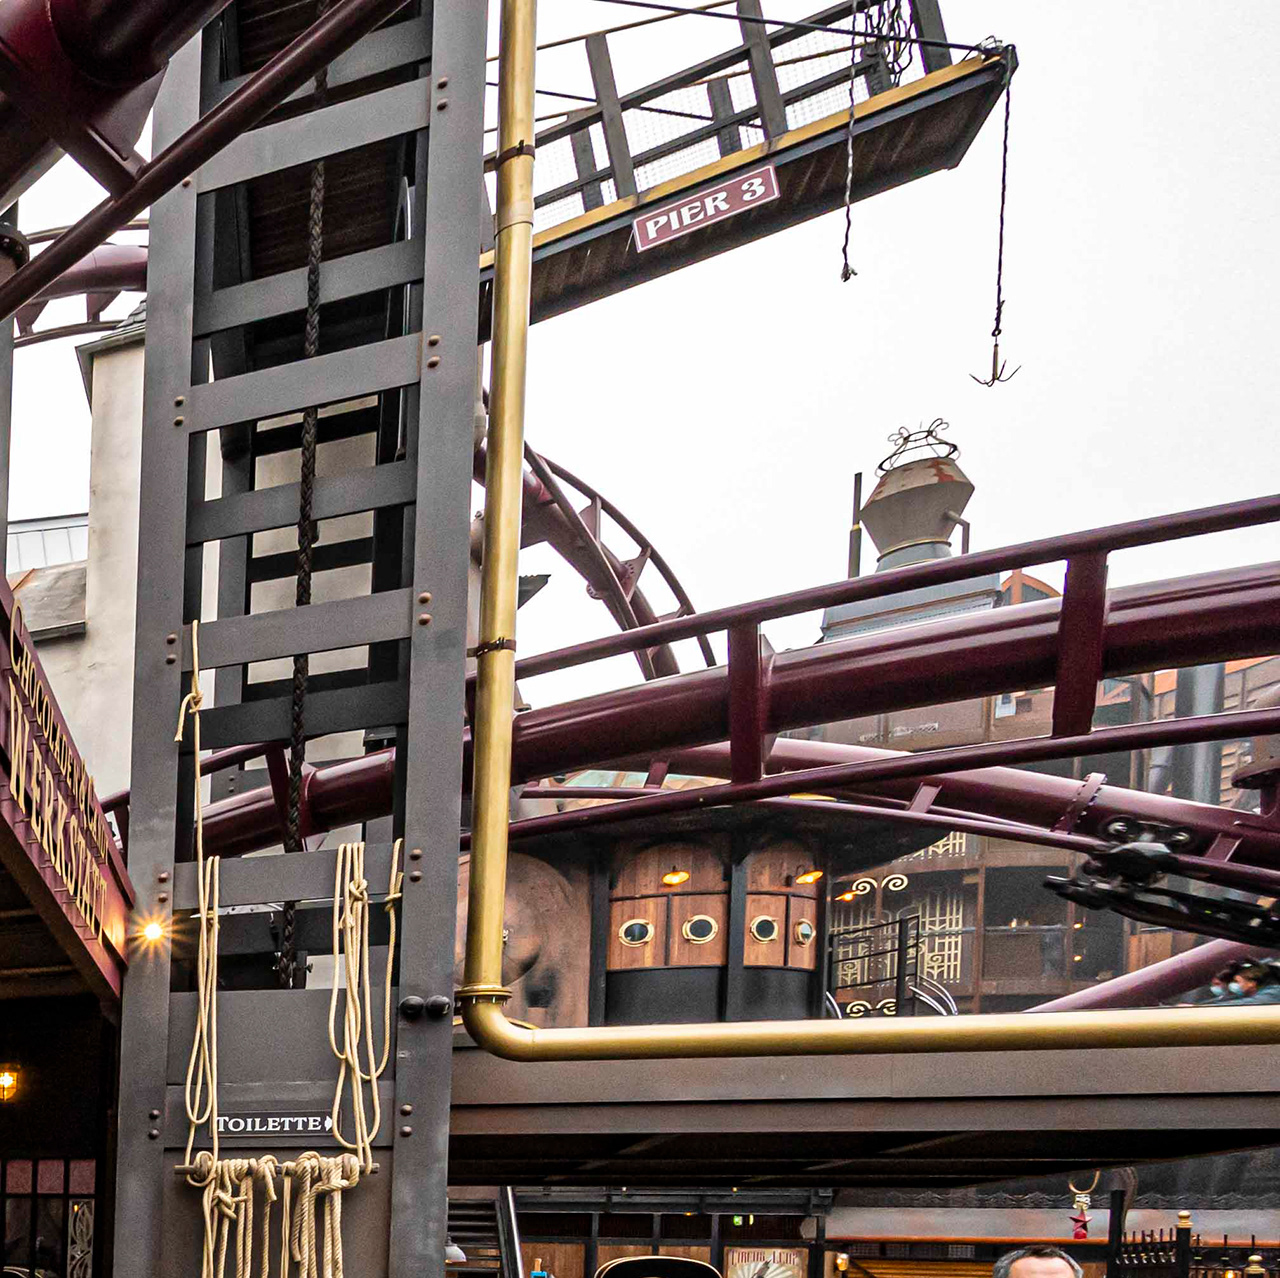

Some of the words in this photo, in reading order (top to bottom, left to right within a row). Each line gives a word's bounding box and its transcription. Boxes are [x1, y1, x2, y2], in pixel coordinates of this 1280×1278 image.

[645, 191, 730, 240] PIER
[741, 177, 766, 201] 3
[8, 675, 108, 946] WERKSTATT
[217, 1116, 322, 1132] TOILETTE
